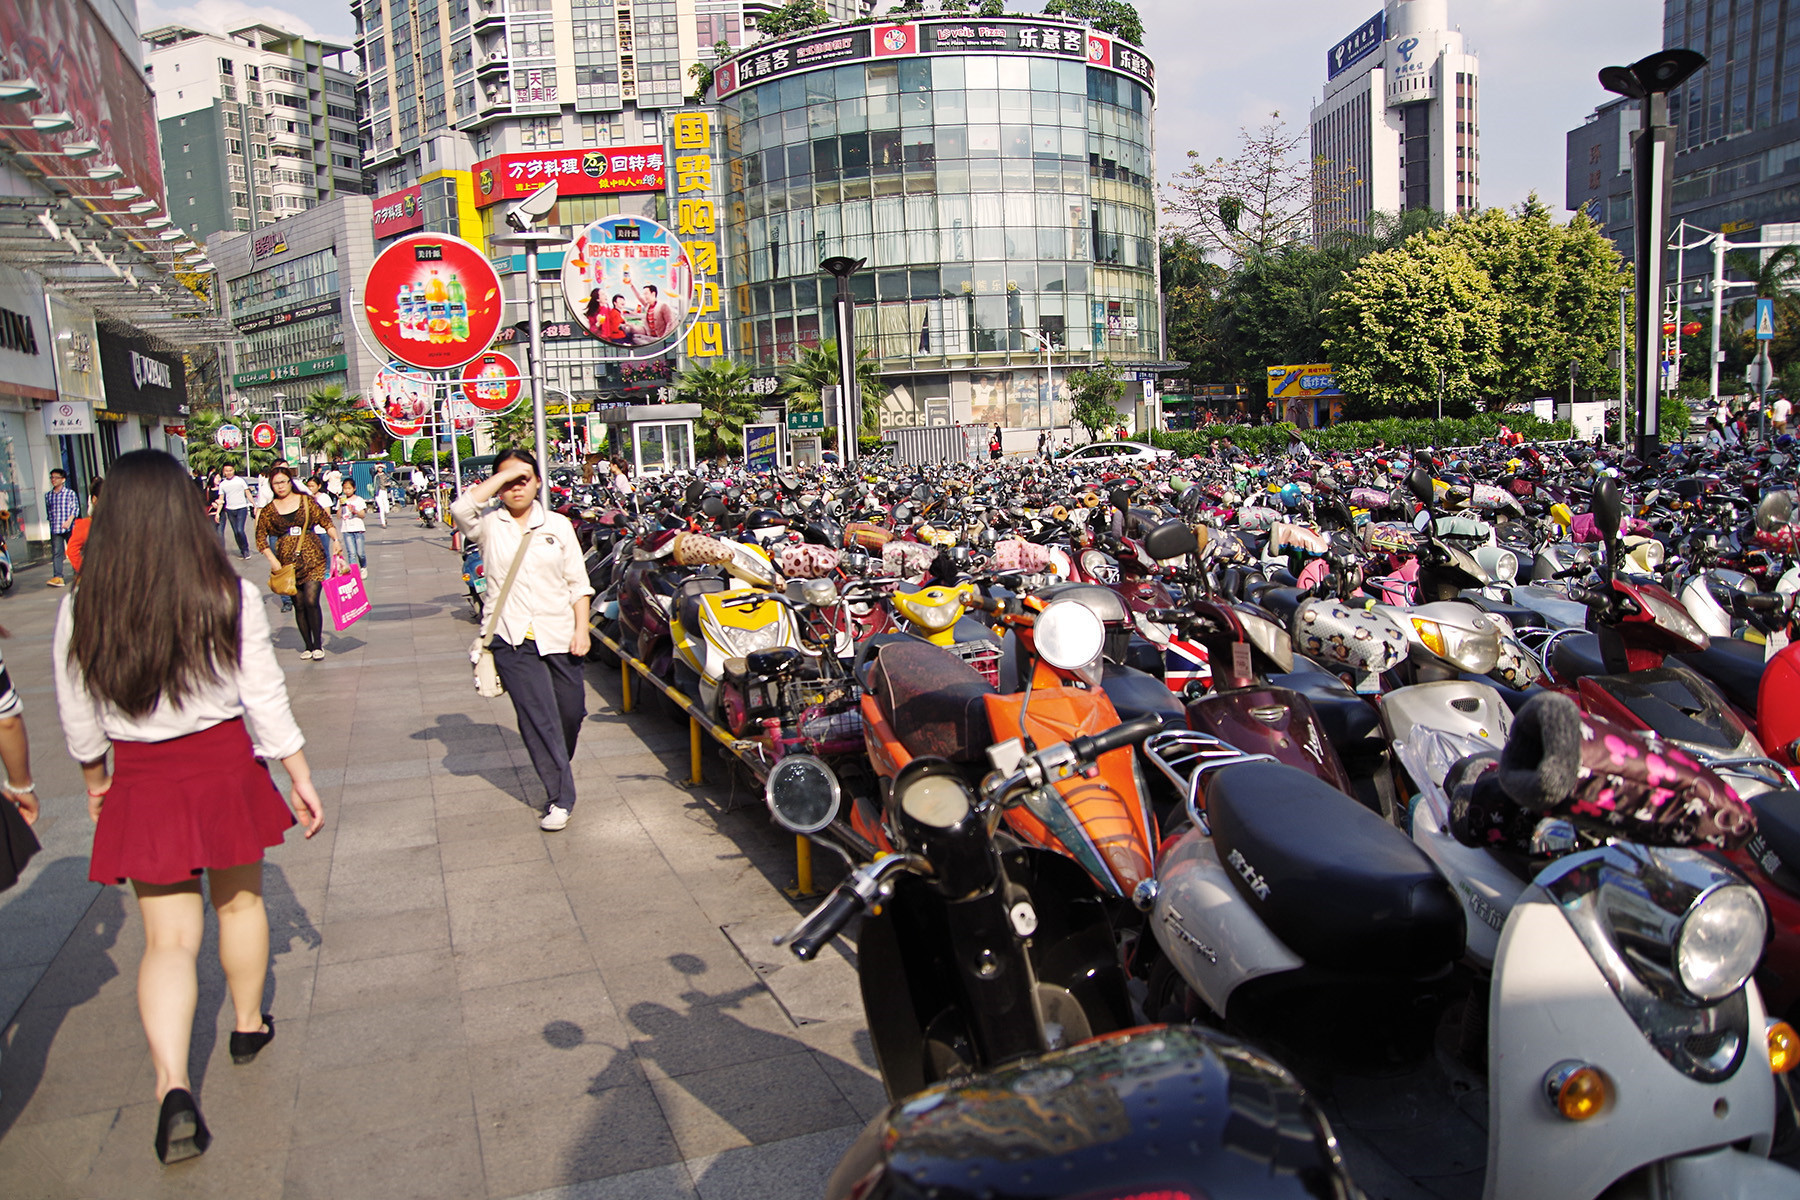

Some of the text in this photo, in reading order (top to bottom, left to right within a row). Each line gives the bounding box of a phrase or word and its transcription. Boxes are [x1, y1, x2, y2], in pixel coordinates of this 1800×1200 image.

[978, 26, 1007, 38] Pizza
[1019, 27, 1081, 51] 乐意客
[741, 49, 789, 80] 乐意客
[1120, 50, 1148, 78] 乐意客
[509, 158, 580, 180] 万岁料理
[617, 229, 639, 238] 美汁源
[674, 113, 723, 357] 国贸购物中心
[418, 249, 442, 259] 美汁源
[53, 418, 82, 426] 中国银行
[792, 414, 819, 423] 共和路
